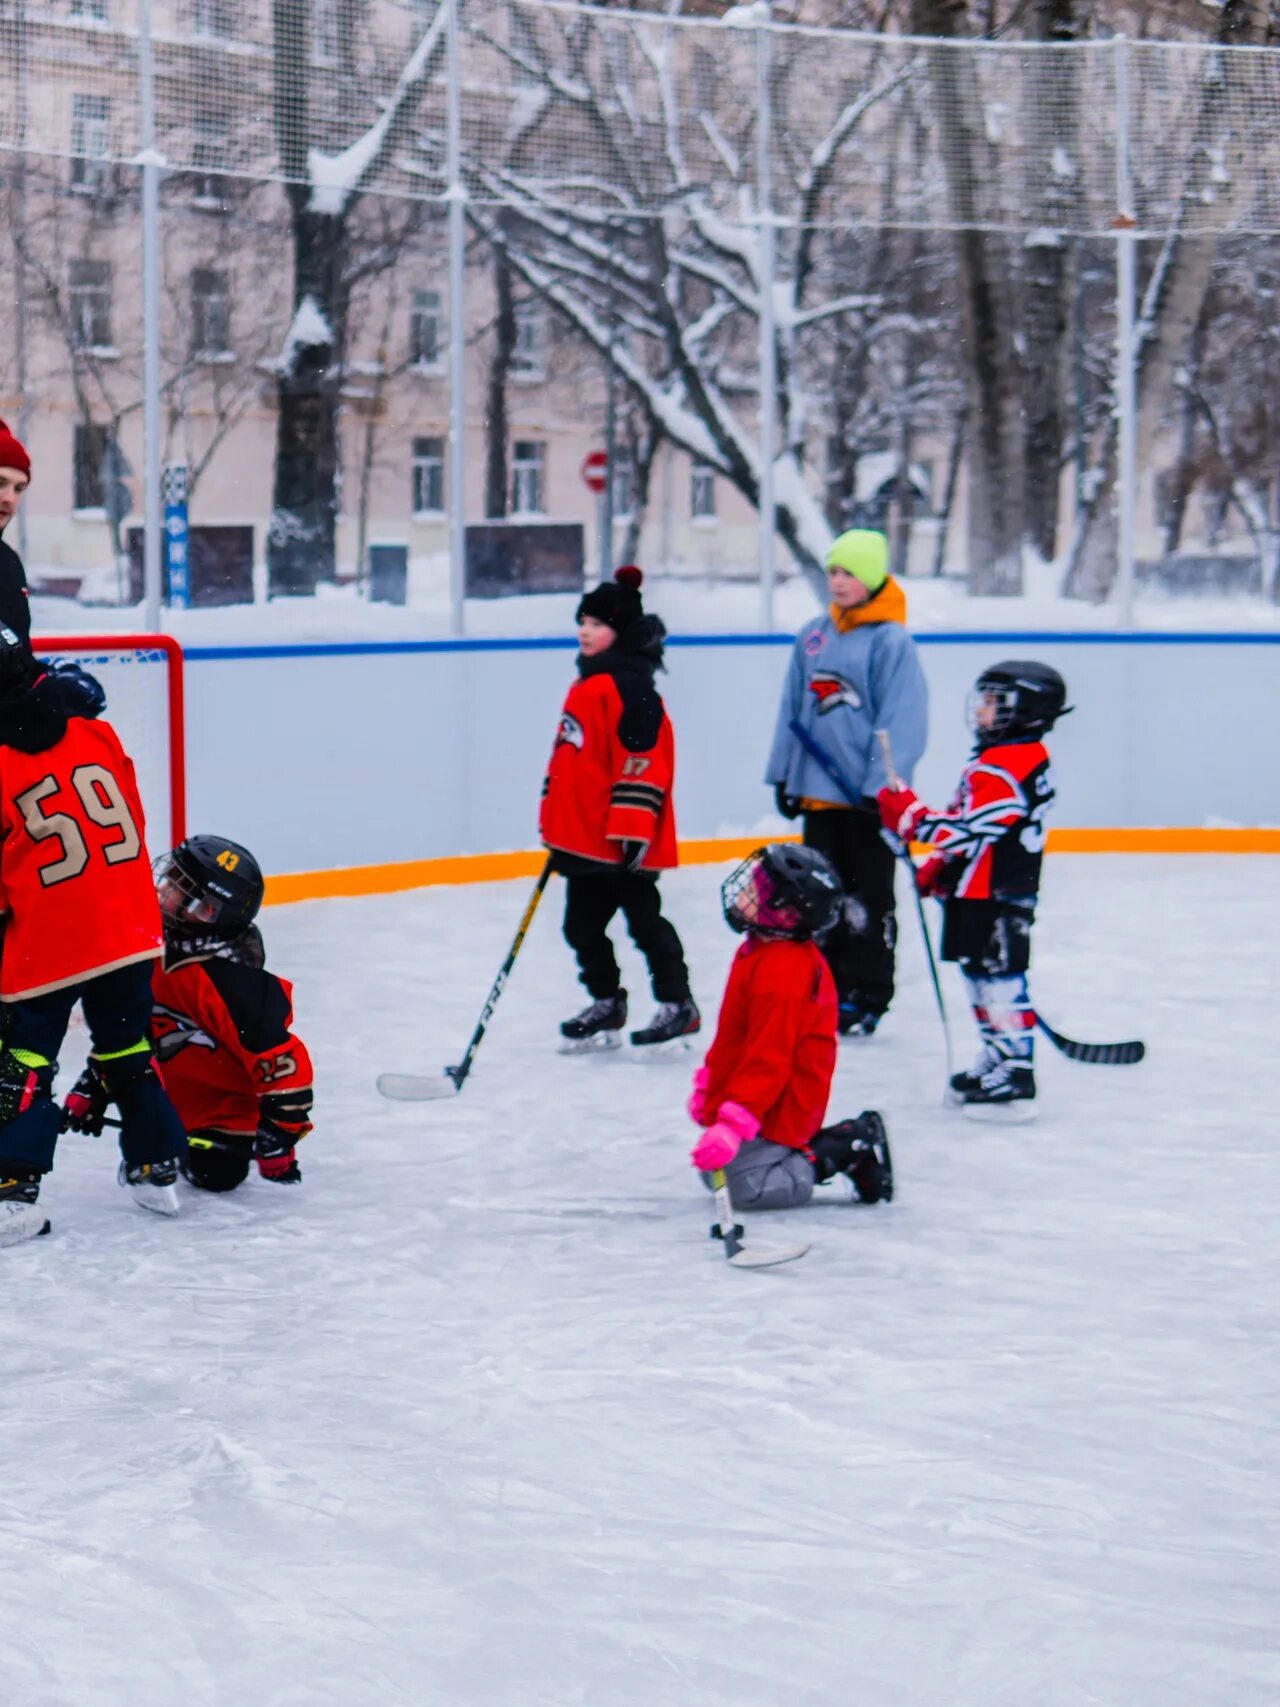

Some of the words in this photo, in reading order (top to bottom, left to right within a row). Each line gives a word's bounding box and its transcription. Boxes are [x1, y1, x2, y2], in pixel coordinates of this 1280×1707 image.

[13, 764, 141, 889] 59
[216, 851, 240, 872] 43
[207, 881, 232, 898] CCM
